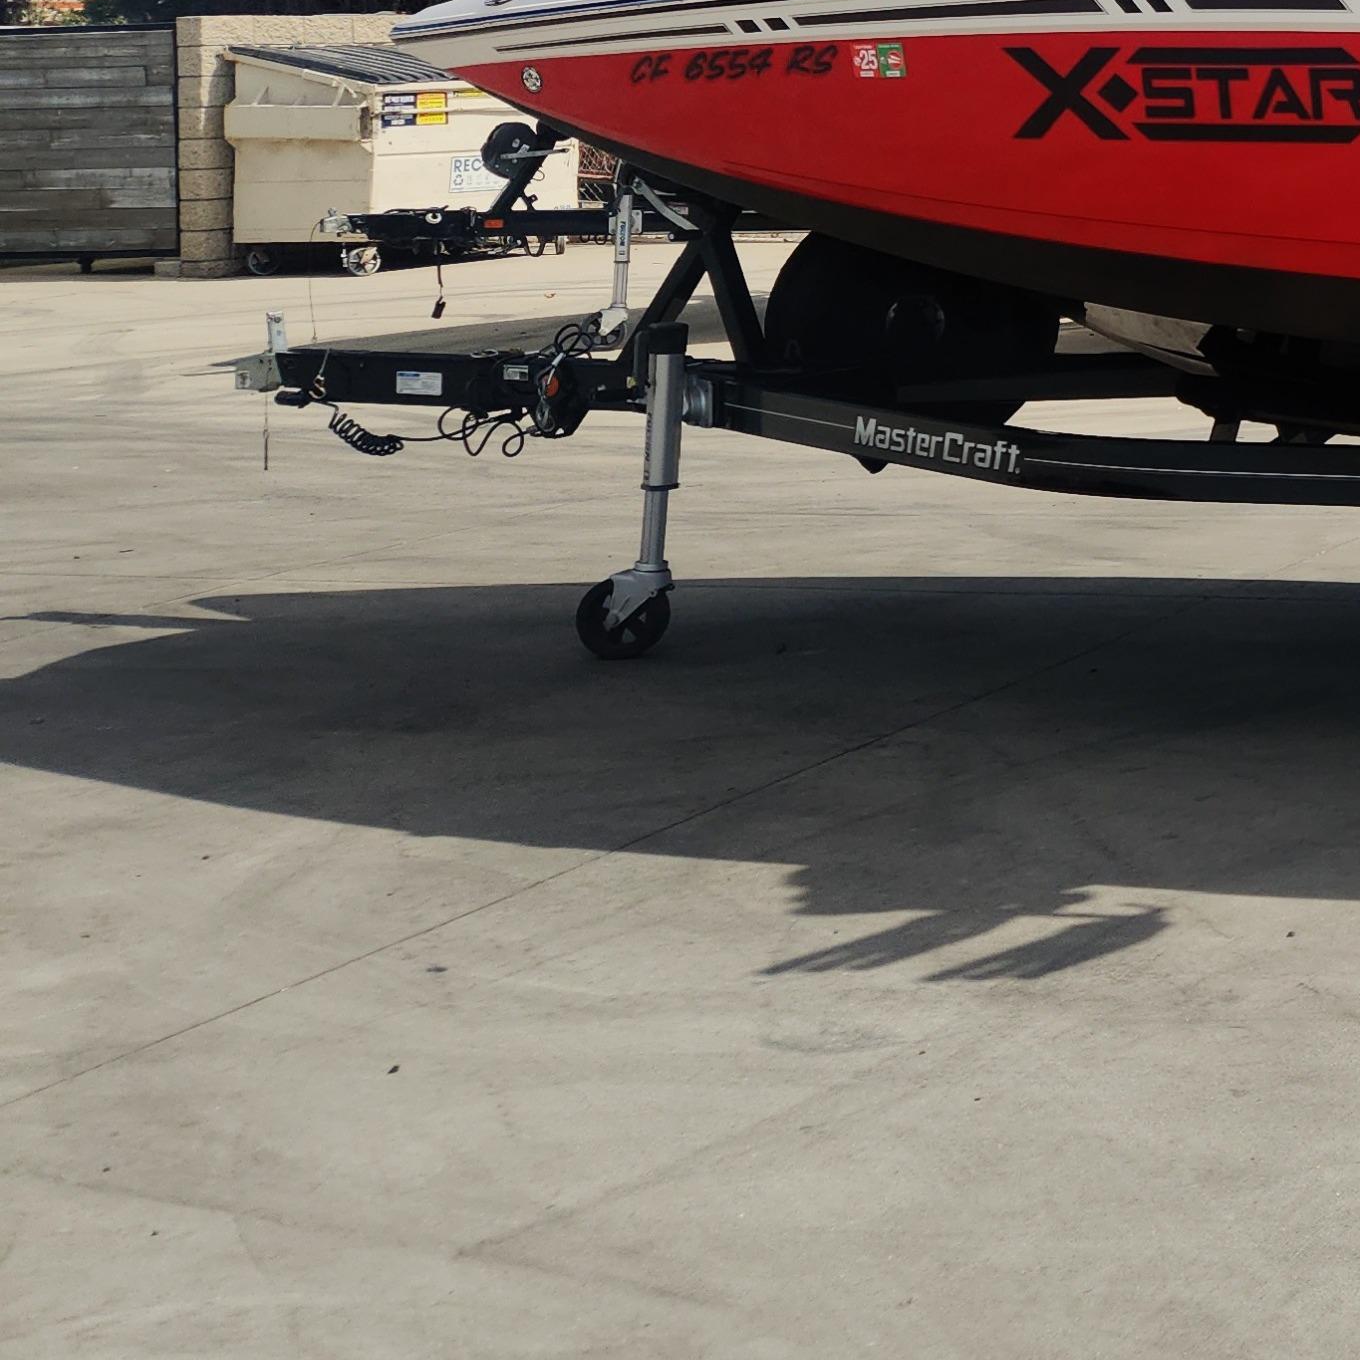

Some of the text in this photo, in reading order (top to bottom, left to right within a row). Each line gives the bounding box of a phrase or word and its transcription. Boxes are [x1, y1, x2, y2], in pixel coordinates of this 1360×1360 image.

[630, 44, 839, 84] CF 6554 RS
[859, 49, 878, 70] 25
[453, 158, 482, 173] REC
[854, 415, 1020, 473] MasterCraft
